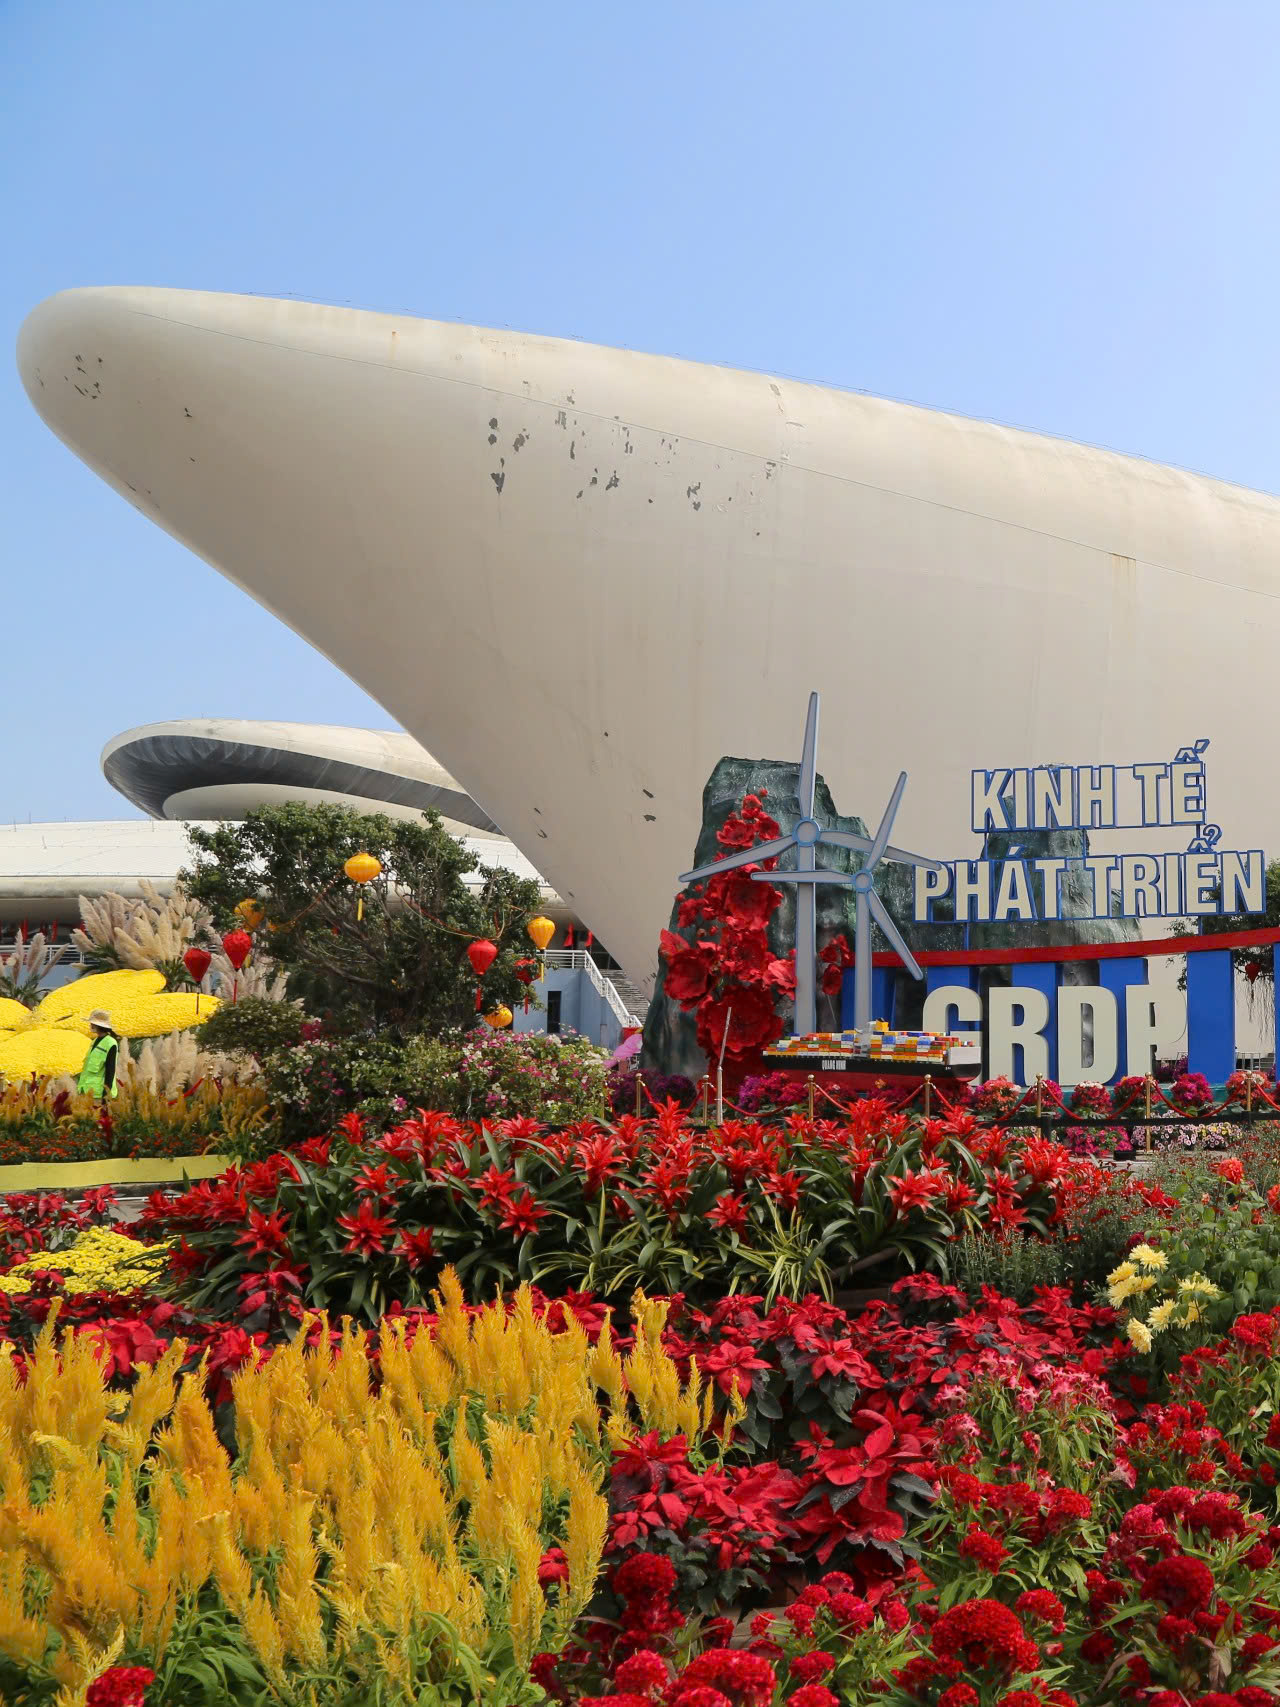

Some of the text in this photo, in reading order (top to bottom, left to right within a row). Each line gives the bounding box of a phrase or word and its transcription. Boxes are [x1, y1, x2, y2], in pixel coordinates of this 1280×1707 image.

[972, 739, 1209, 832] KINH TẾ
[912, 824, 1266, 924] PHÁT TRIỂN
[922, 984, 1188, 1087] GRDP
